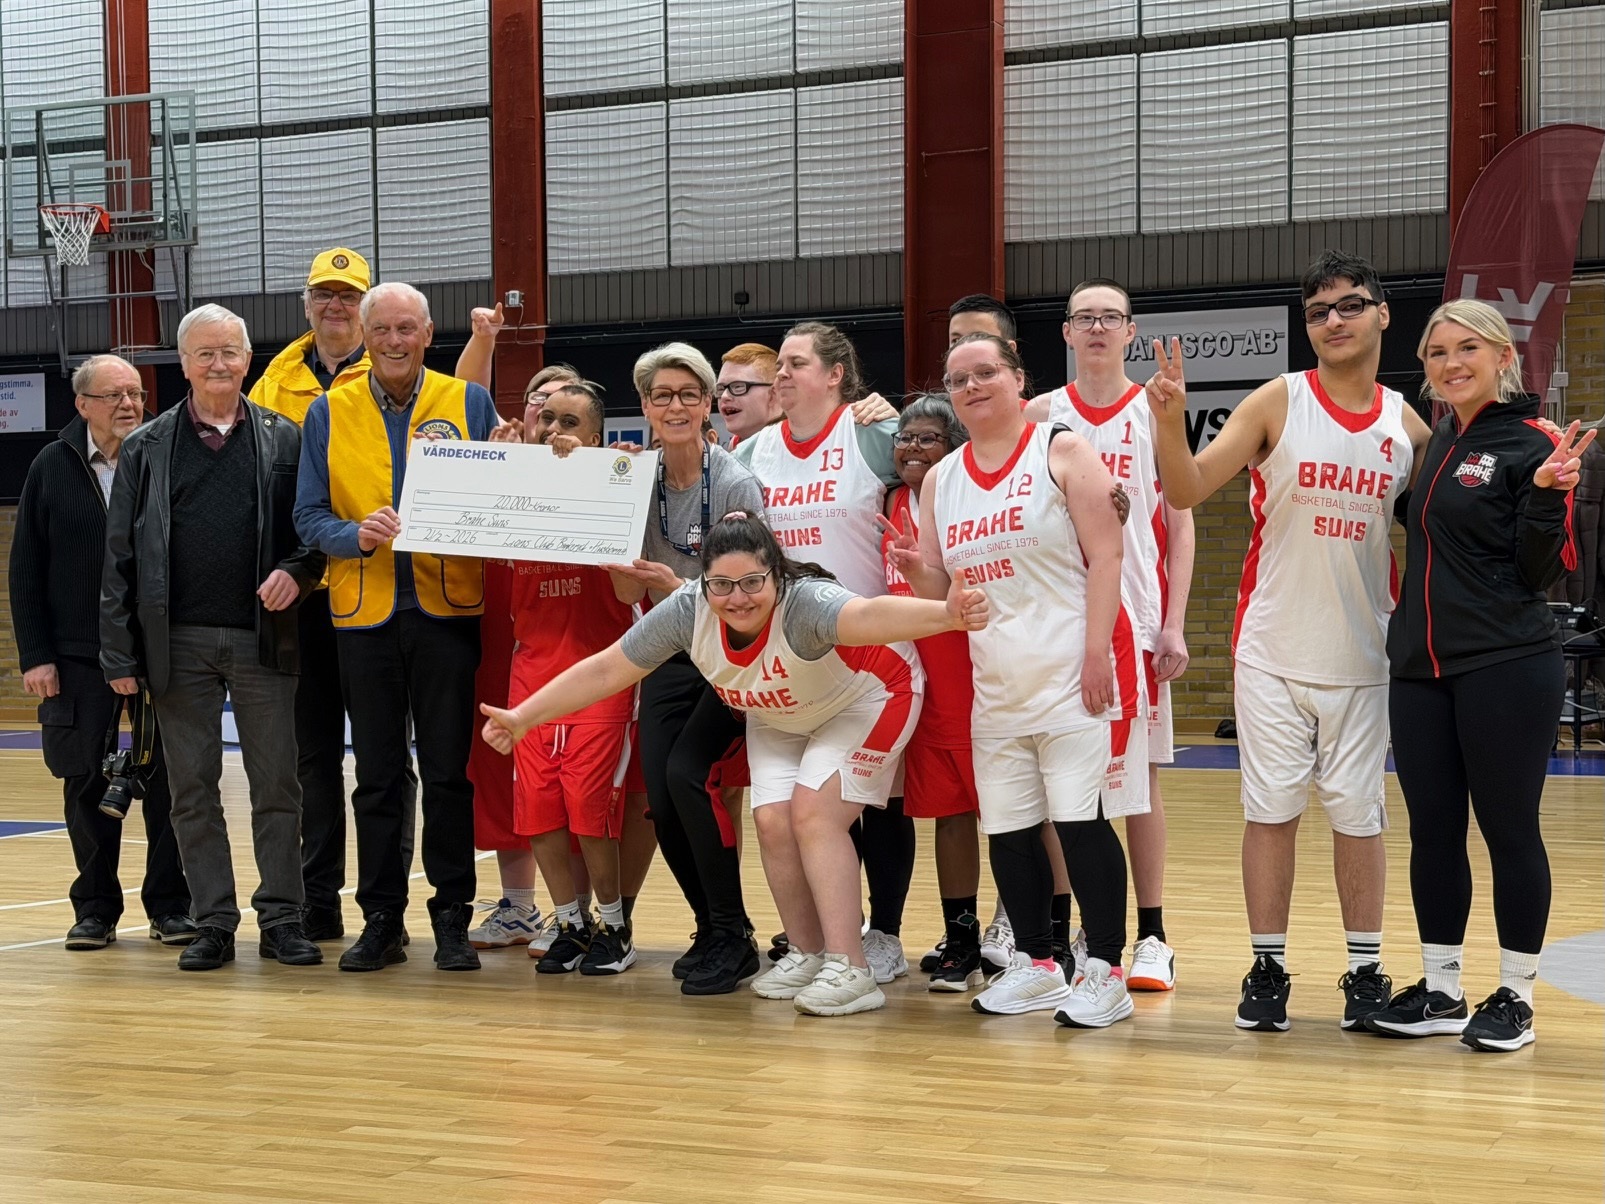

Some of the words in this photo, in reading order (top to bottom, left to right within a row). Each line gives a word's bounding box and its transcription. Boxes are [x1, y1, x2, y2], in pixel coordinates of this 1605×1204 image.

[1124, 331, 1235, 362] ANESCO
[1241, 329, 1278, 356] AB
[424, 423, 449, 432] LIONS
[1121, 421, 1132, 444] 1
[422, 445, 507, 461] VÄRDECHECK
[1380, 436, 1393, 463] 4
[819, 448, 844, 472] 13
[1298, 462, 1393, 499] BRAHE
[1455, 463, 1494, 482] BRAHE
[1005, 473, 1033, 500] 12
[766, 513, 798, 523] ETBALL
[800, 510, 823, 520] SINCE
[825, 509, 847, 518] 1976
[1348, 501, 1374, 513] SINCE
[773, 527, 822, 548] SUNS
[946, 506, 1024, 550] BRAHE
[1314, 516, 1367, 542] SUNS
[502, 533, 530, 547] Lions
[534, 535, 556, 550] Club
[987, 540, 1012, 553] SINCE
[1015, 537, 1039, 548] 1976
[964, 558, 1015, 586] SUNS
[540, 577, 581, 597] SUNS
[761, 656, 789, 681] 14
[851, 752, 886, 764] BRAHE
[852, 767, 872, 777] SUNS
[1109, 781, 1122, 790] SUNS
